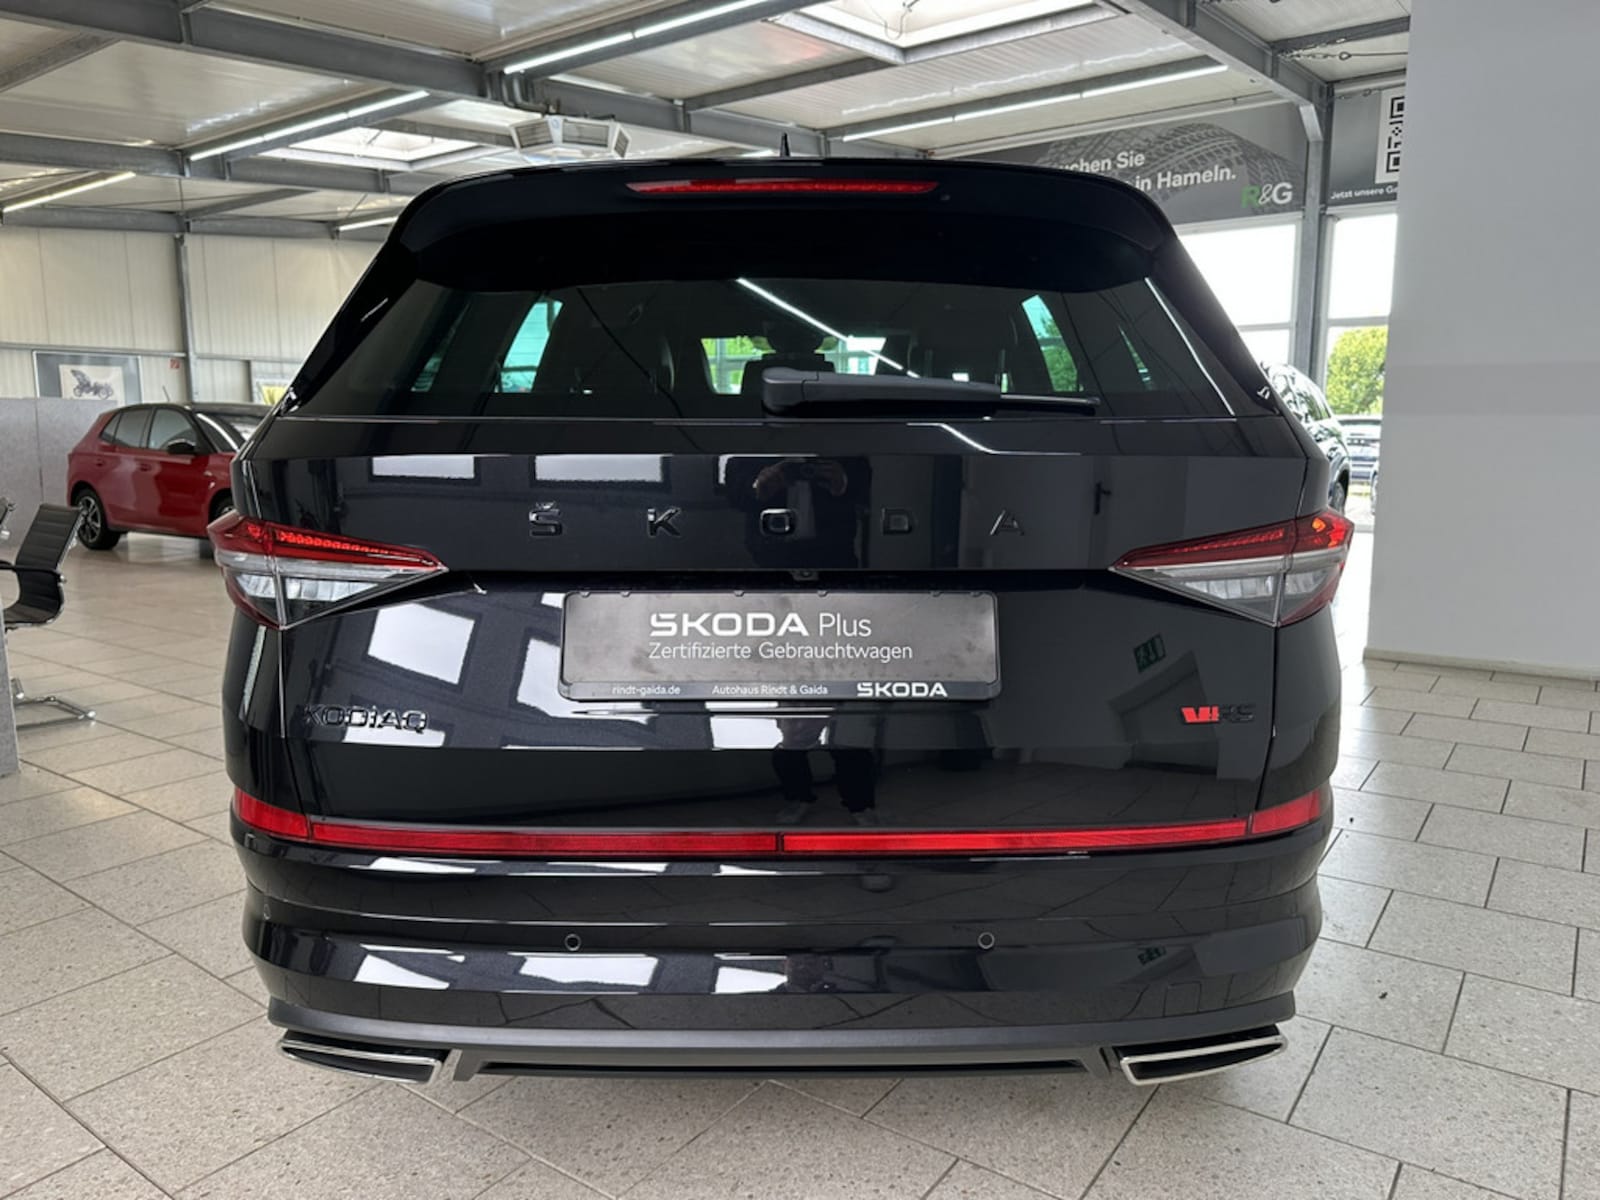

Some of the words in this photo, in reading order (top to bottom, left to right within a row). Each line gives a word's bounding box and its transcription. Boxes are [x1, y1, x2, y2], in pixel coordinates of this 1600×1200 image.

[1116, 150, 1146, 169] Sie
[1135, 175, 1152, 191] in
[1156, 164, 1237, 189] Hameln.
[1241, 182, 1293, 208] R&G
[1331, 189, 1353, 200] Jetzt
[1354, 187, 1385, 197] unsere
[819, 612, 872, 637] Plus
[648, 641, 752, 660] Zertifizierte
[758, 641, 913, 664] Gebrauchtwagen
[612, 684, 681, 697] rindt-gaida.de
[711, 684, 758, 696] Autohaus
[760, 684, 788, 696] Rindt
[790, 684, 798, 696] &
[800, 684, 829, 696] Gaida
